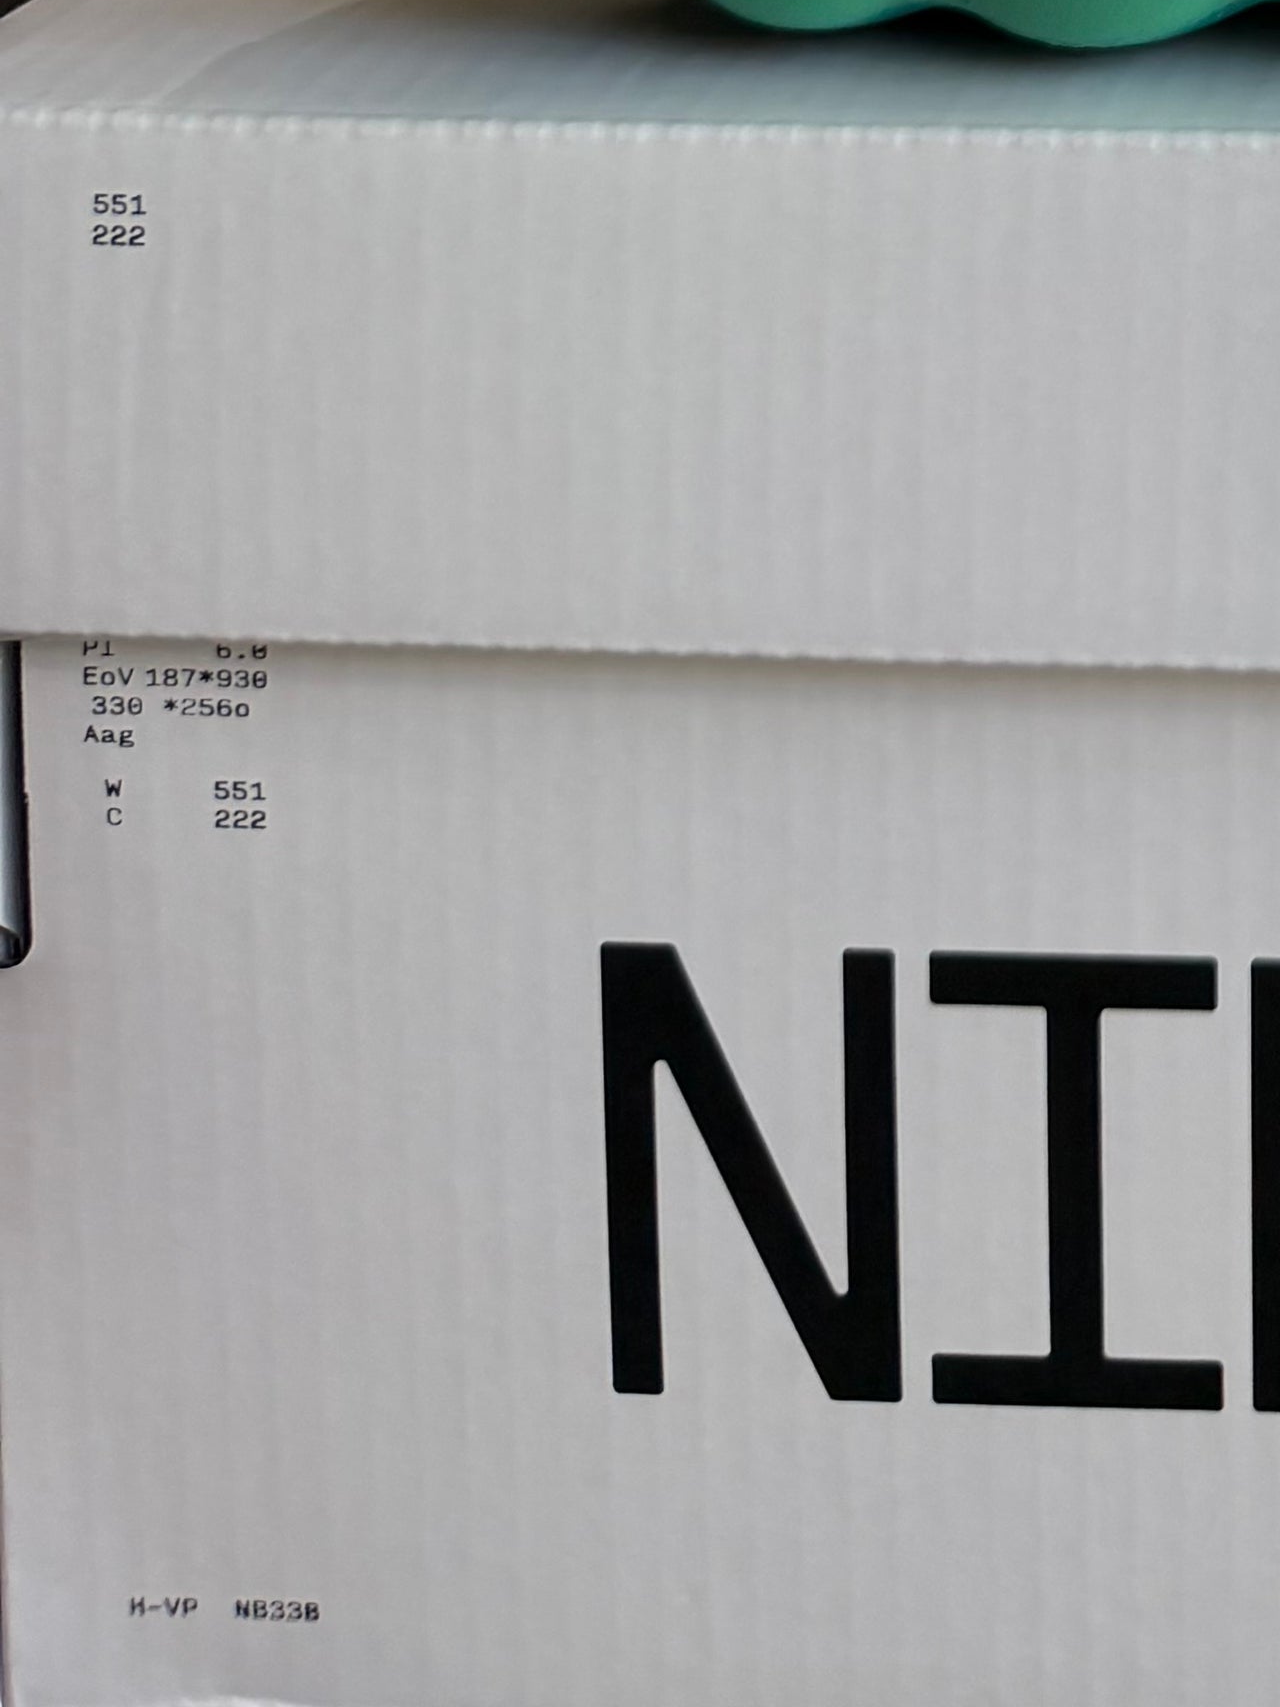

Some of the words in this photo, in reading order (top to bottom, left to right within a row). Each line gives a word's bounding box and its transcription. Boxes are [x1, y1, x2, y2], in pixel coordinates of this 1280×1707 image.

[92, 193, 147, 215] 551
[92, 224, 146, 246] 222
[82, 666, 134, 686] EoV
[91, 696, 143, 716] 330
[83, 725, 135, 748] Aag
[104, 778, 123, 798] W
[213, 780, 267, 801] 551
[106, 807, 123, 826] C
[213, 810, 267, 830] 222
